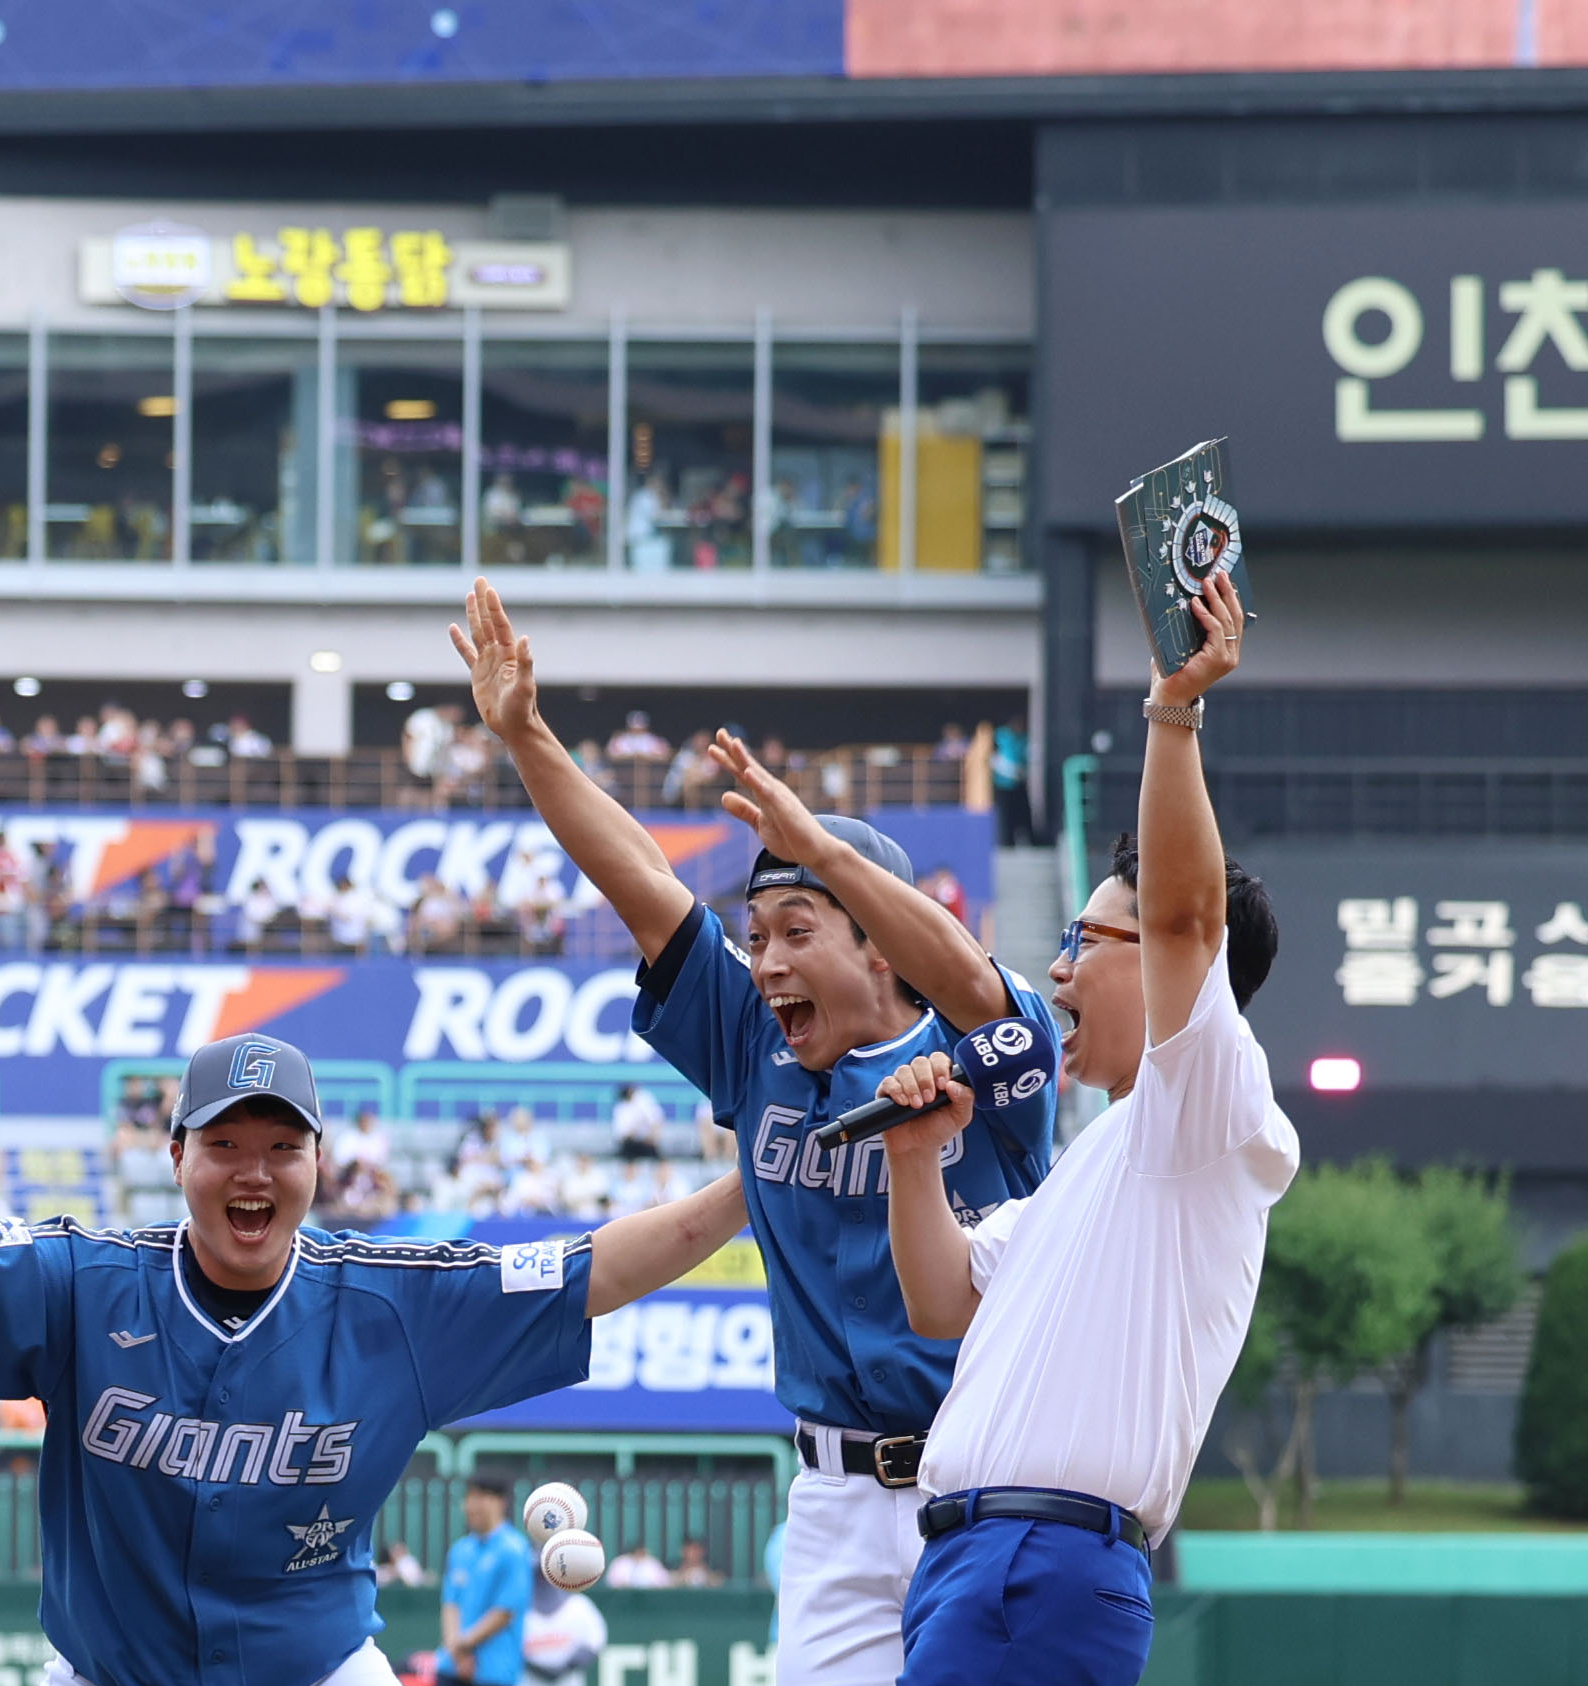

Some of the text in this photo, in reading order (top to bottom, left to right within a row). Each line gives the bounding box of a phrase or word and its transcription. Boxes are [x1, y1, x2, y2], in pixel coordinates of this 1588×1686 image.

[970, 1033, 1000, 1067] KBO
[993, 1081, 1010, 1108] KBO
[81, 1384, 363, 1486] Giants
